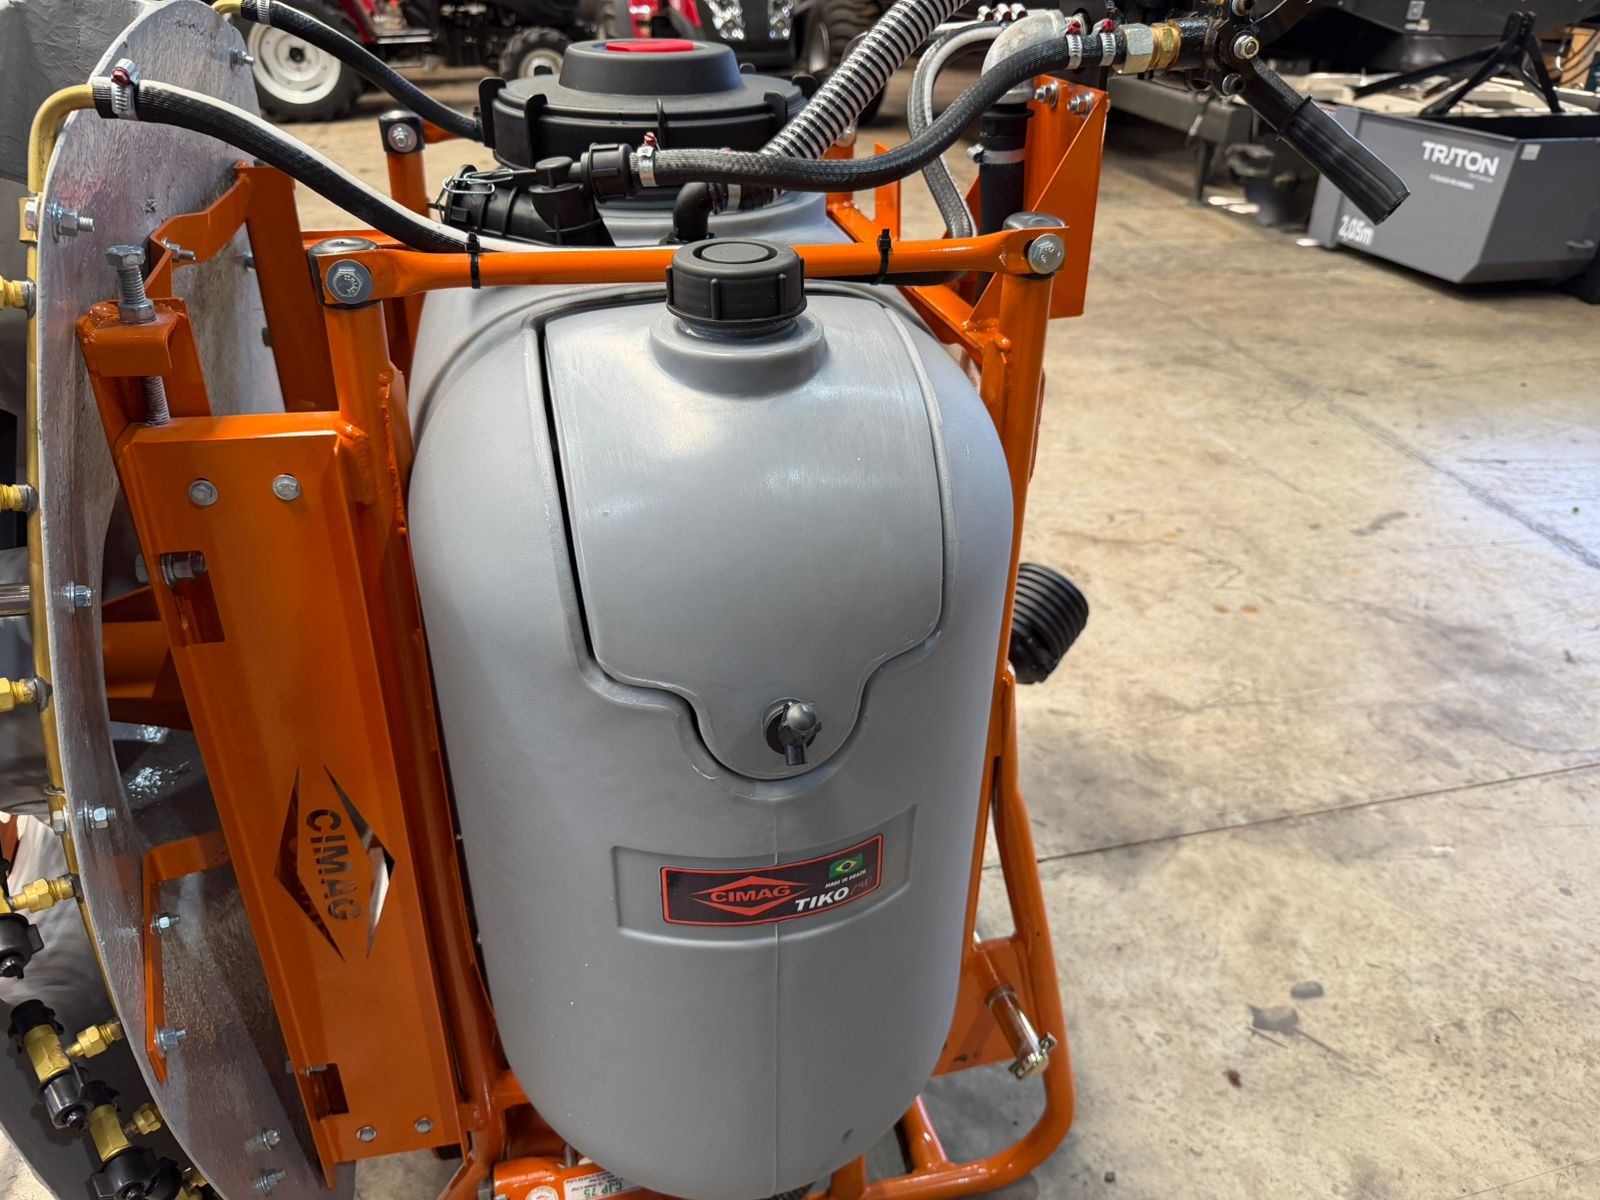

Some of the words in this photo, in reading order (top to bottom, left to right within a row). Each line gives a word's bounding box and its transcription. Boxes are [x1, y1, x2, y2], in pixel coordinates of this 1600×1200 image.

[1421, 141, 1500, 176] TRITON
[305, 808, 362, 921] CIMAG
[710, 885, 791, 903] CIMAG
[824, 879, 841, 889] MADE
[841, 876, 848, 884] IN
[795, 886, 850, 911] TIKO
